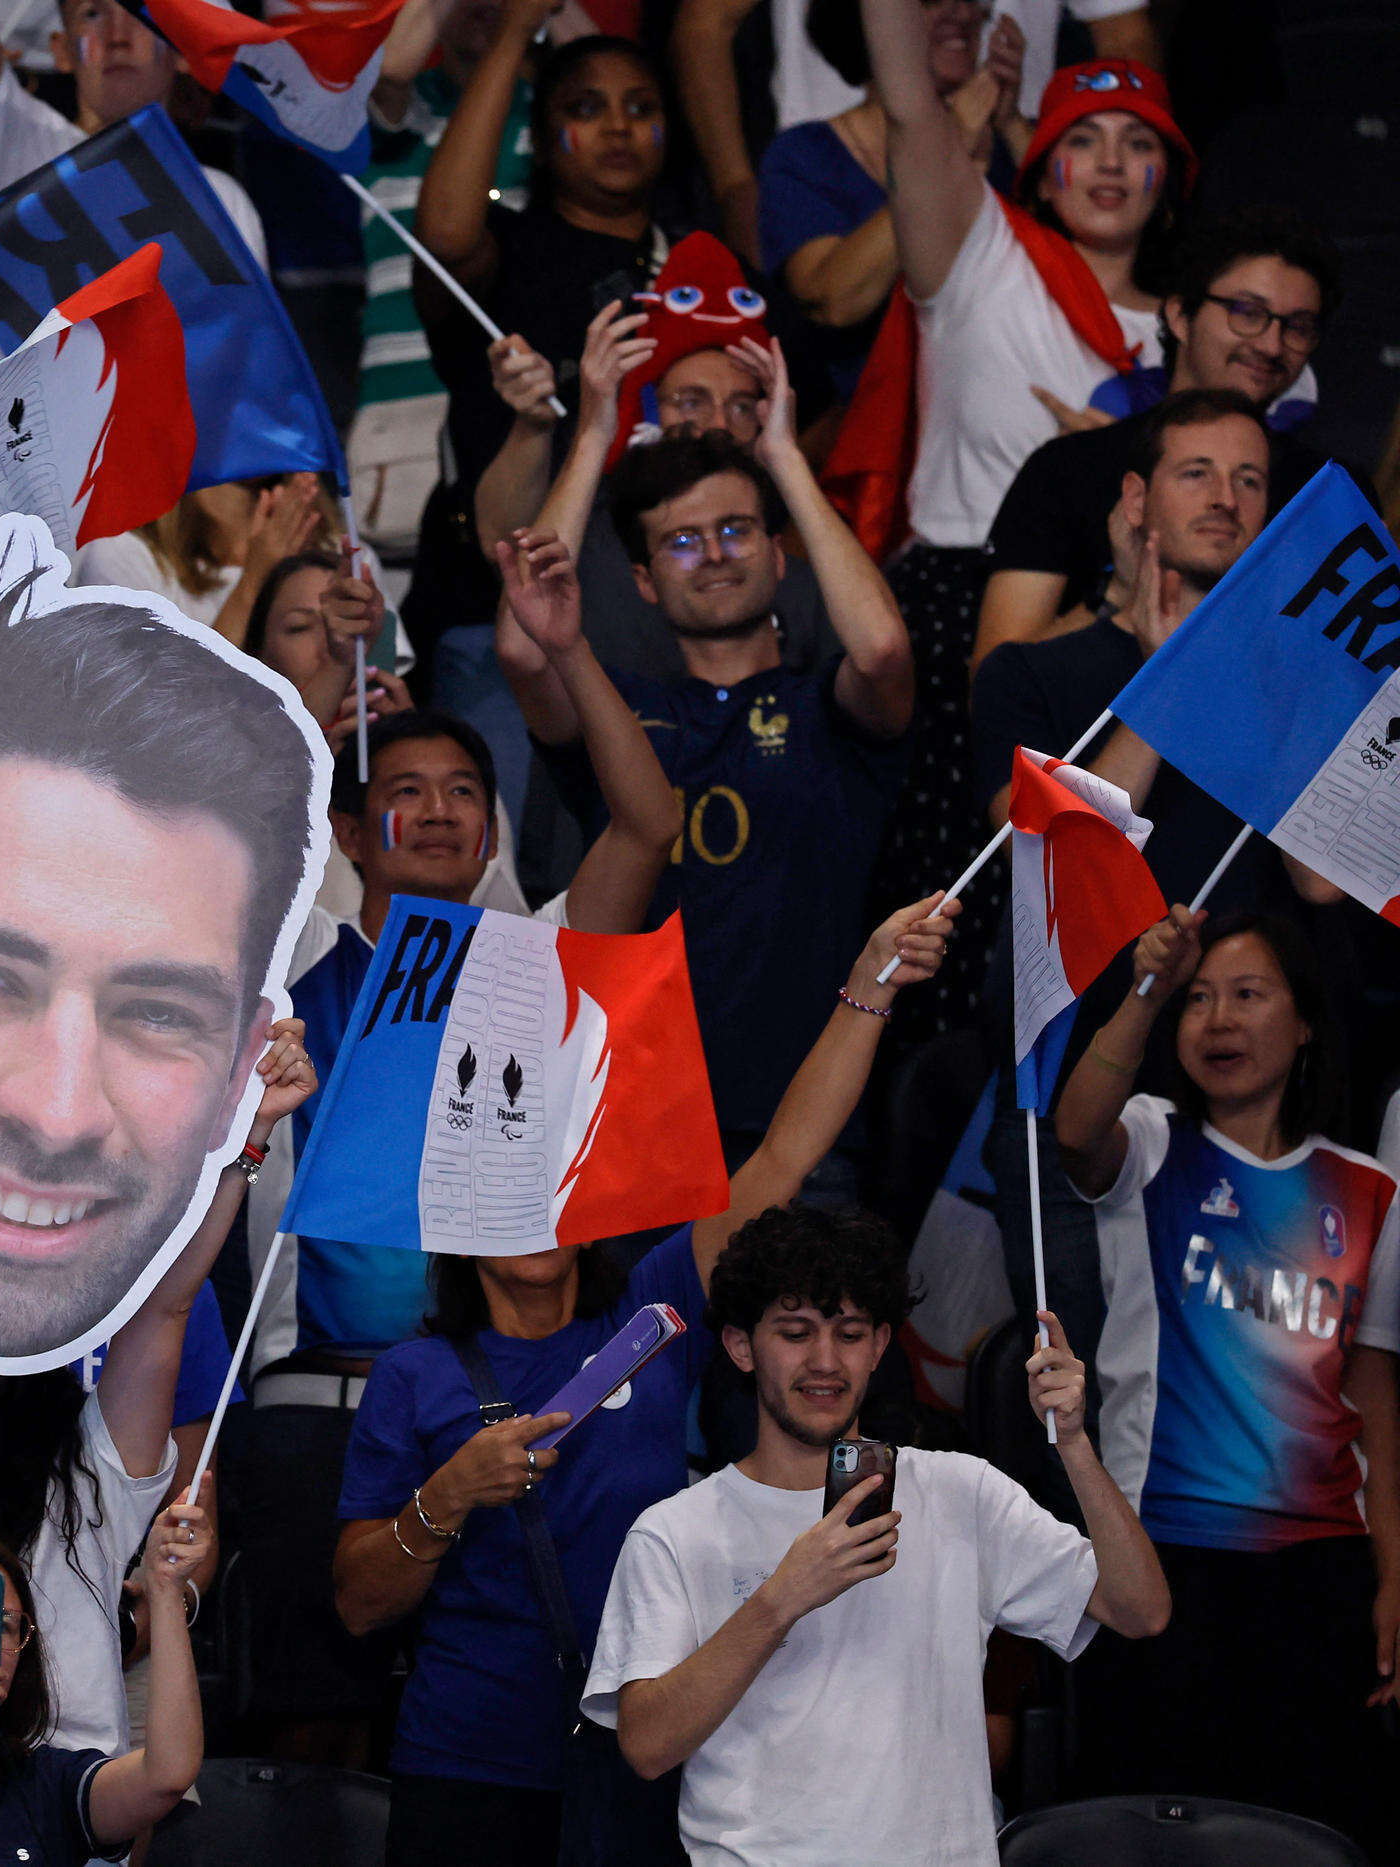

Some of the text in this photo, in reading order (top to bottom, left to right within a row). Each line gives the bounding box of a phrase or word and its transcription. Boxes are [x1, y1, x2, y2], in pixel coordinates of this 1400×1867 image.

[1367, 736, 1397, 762] FRANCE
[448, 1097, 474, 1114] FRANCE
[497, 1107, 527, 1123] FRANCE
